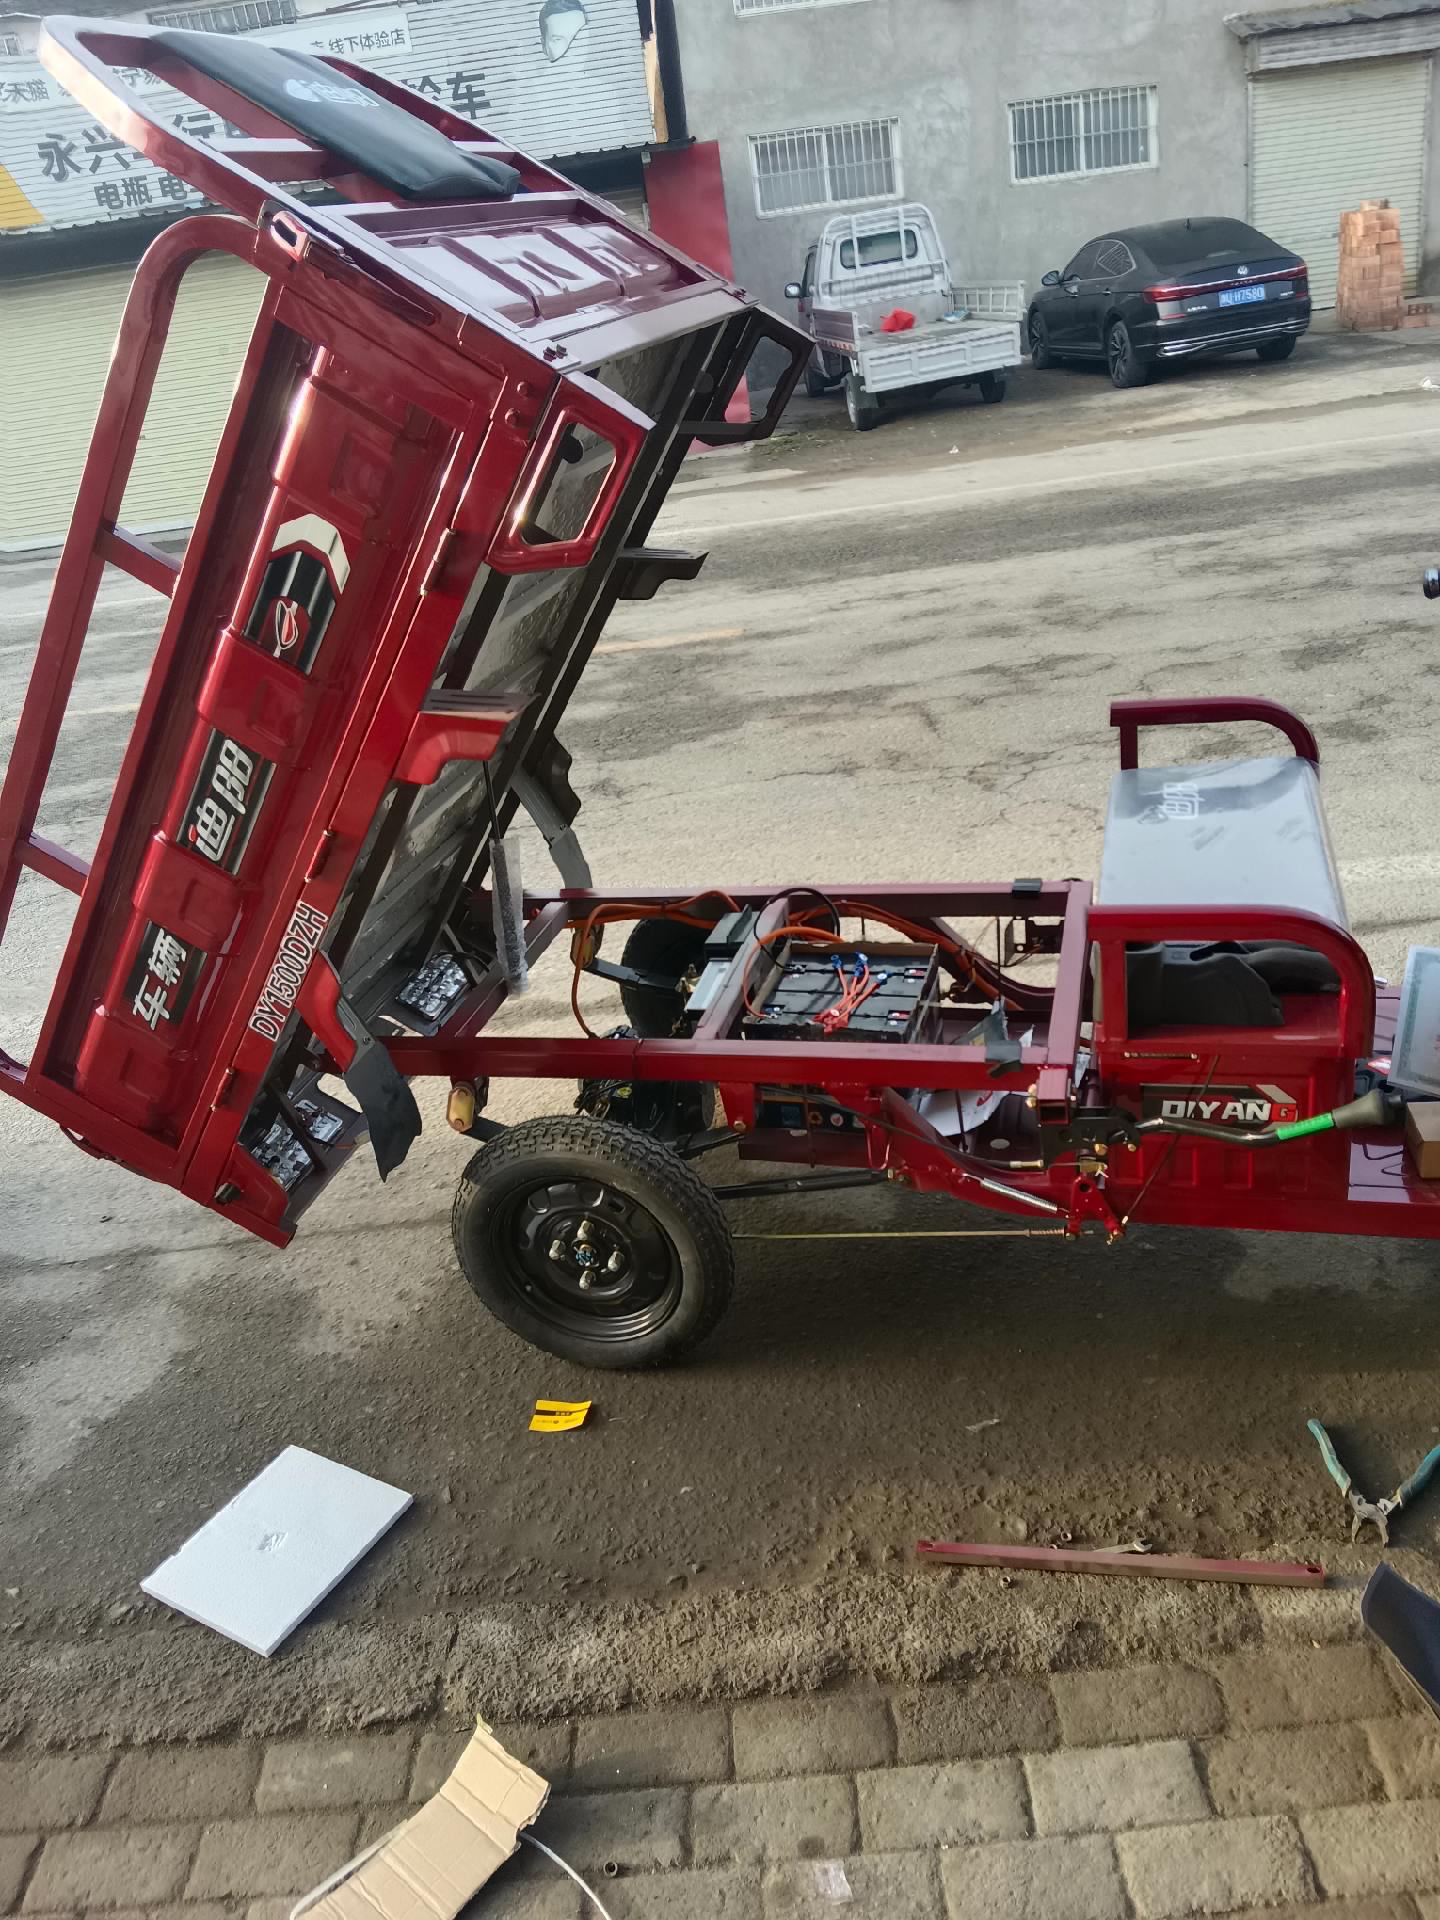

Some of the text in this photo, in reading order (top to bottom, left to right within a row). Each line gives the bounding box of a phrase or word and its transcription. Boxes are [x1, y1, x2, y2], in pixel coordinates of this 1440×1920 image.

[328, 28, 405, 54] 线下体验店
[93, 175, 152, 209] 电瓶
[189, 739, 253, 861] 迪阳
[132, 928, 186, 1031] 车辆
[249, 900, 328, 1042] DY1500DZH
[1161, 1099, 1298, 1122] DIYANG
